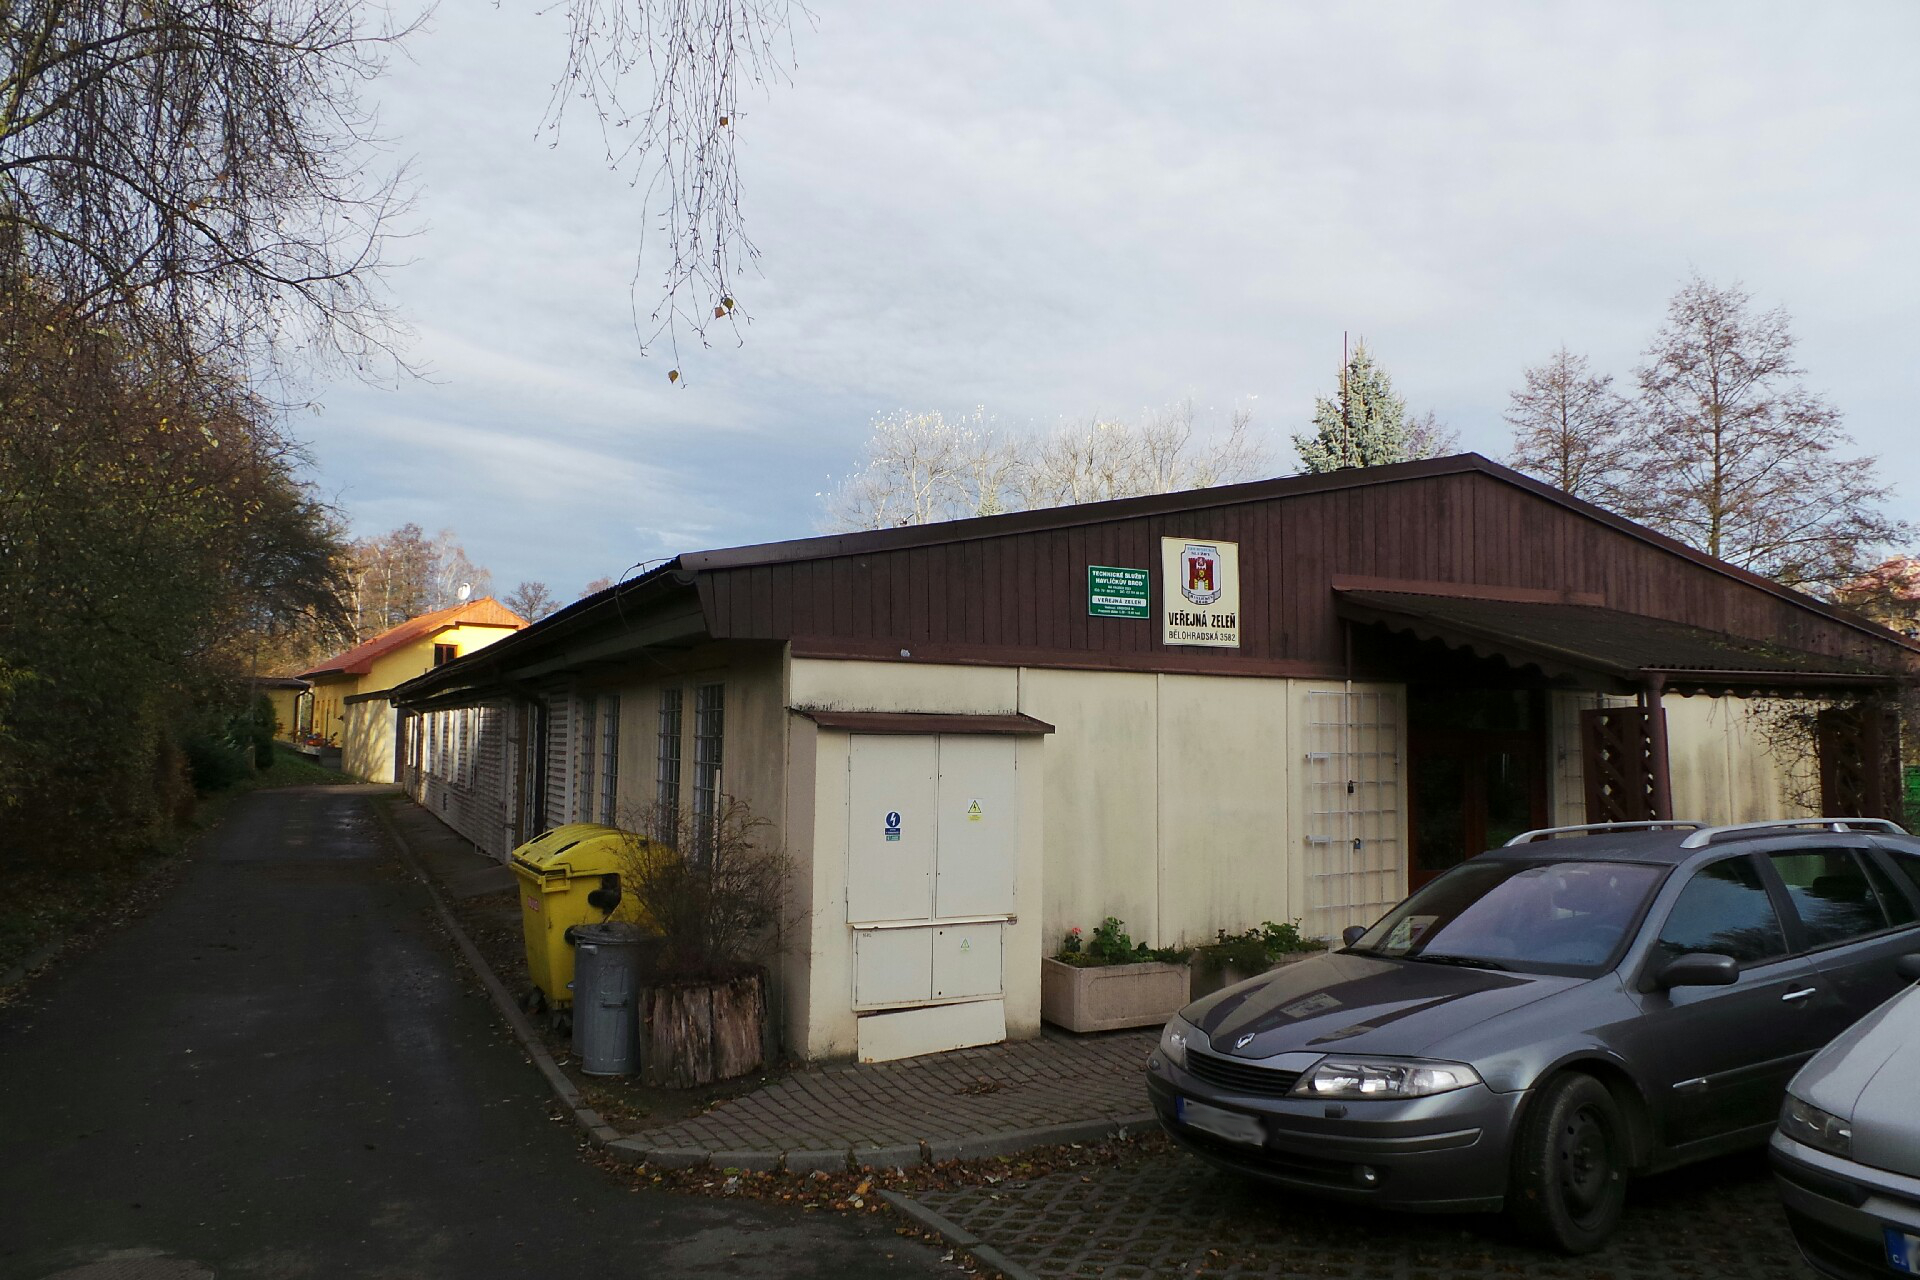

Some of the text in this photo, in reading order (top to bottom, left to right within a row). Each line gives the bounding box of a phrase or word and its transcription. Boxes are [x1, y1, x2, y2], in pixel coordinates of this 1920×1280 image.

[1125, 572, 1146, 580] SLUŽBY
[1168, 610, 1236, 629] VEŘEJNÁ ZELEŇ
[1168, 630, 1236, 642] BĚLOHRADSKÁ 3582
